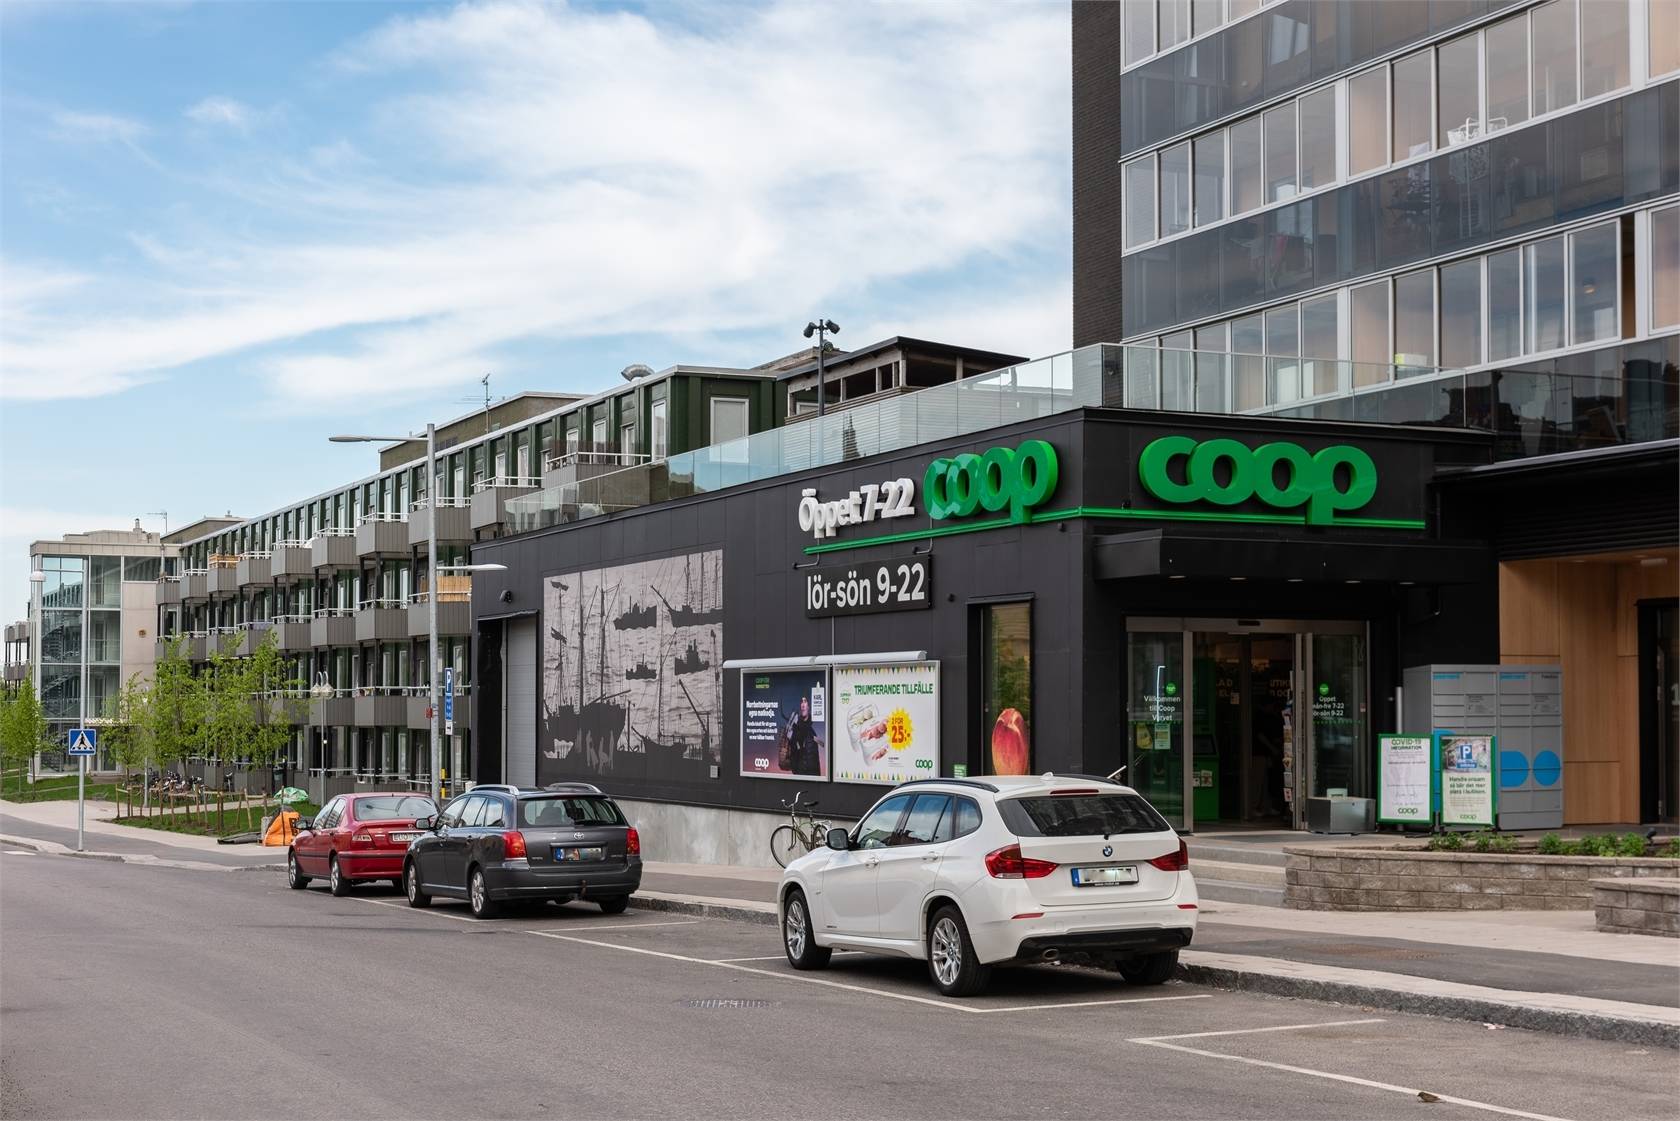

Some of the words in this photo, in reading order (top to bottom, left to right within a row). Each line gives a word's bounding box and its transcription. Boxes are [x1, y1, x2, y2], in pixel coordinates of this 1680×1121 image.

[923, 440, 1059, 523] coop
[1140, 436, 1377, 524] coop
[799, 488, 862, 538] Öppet
[860, 478, 915, 521] 7-22
[807, 570, 871, 610] lör-sön
[876, 563, 925, 604] 9-22
[854, 683, 901, 695] TRIUMFERANDE
[901, 681, 934, 694] TILLFÄLLE
[1159, 704, 1176, 714] Coop
[1463, 746, 1471, 759] P
[754, 758, 769, 769] coop
[915, 759, 934, 771] coop
[1398, 807, 1418, 815] coop
